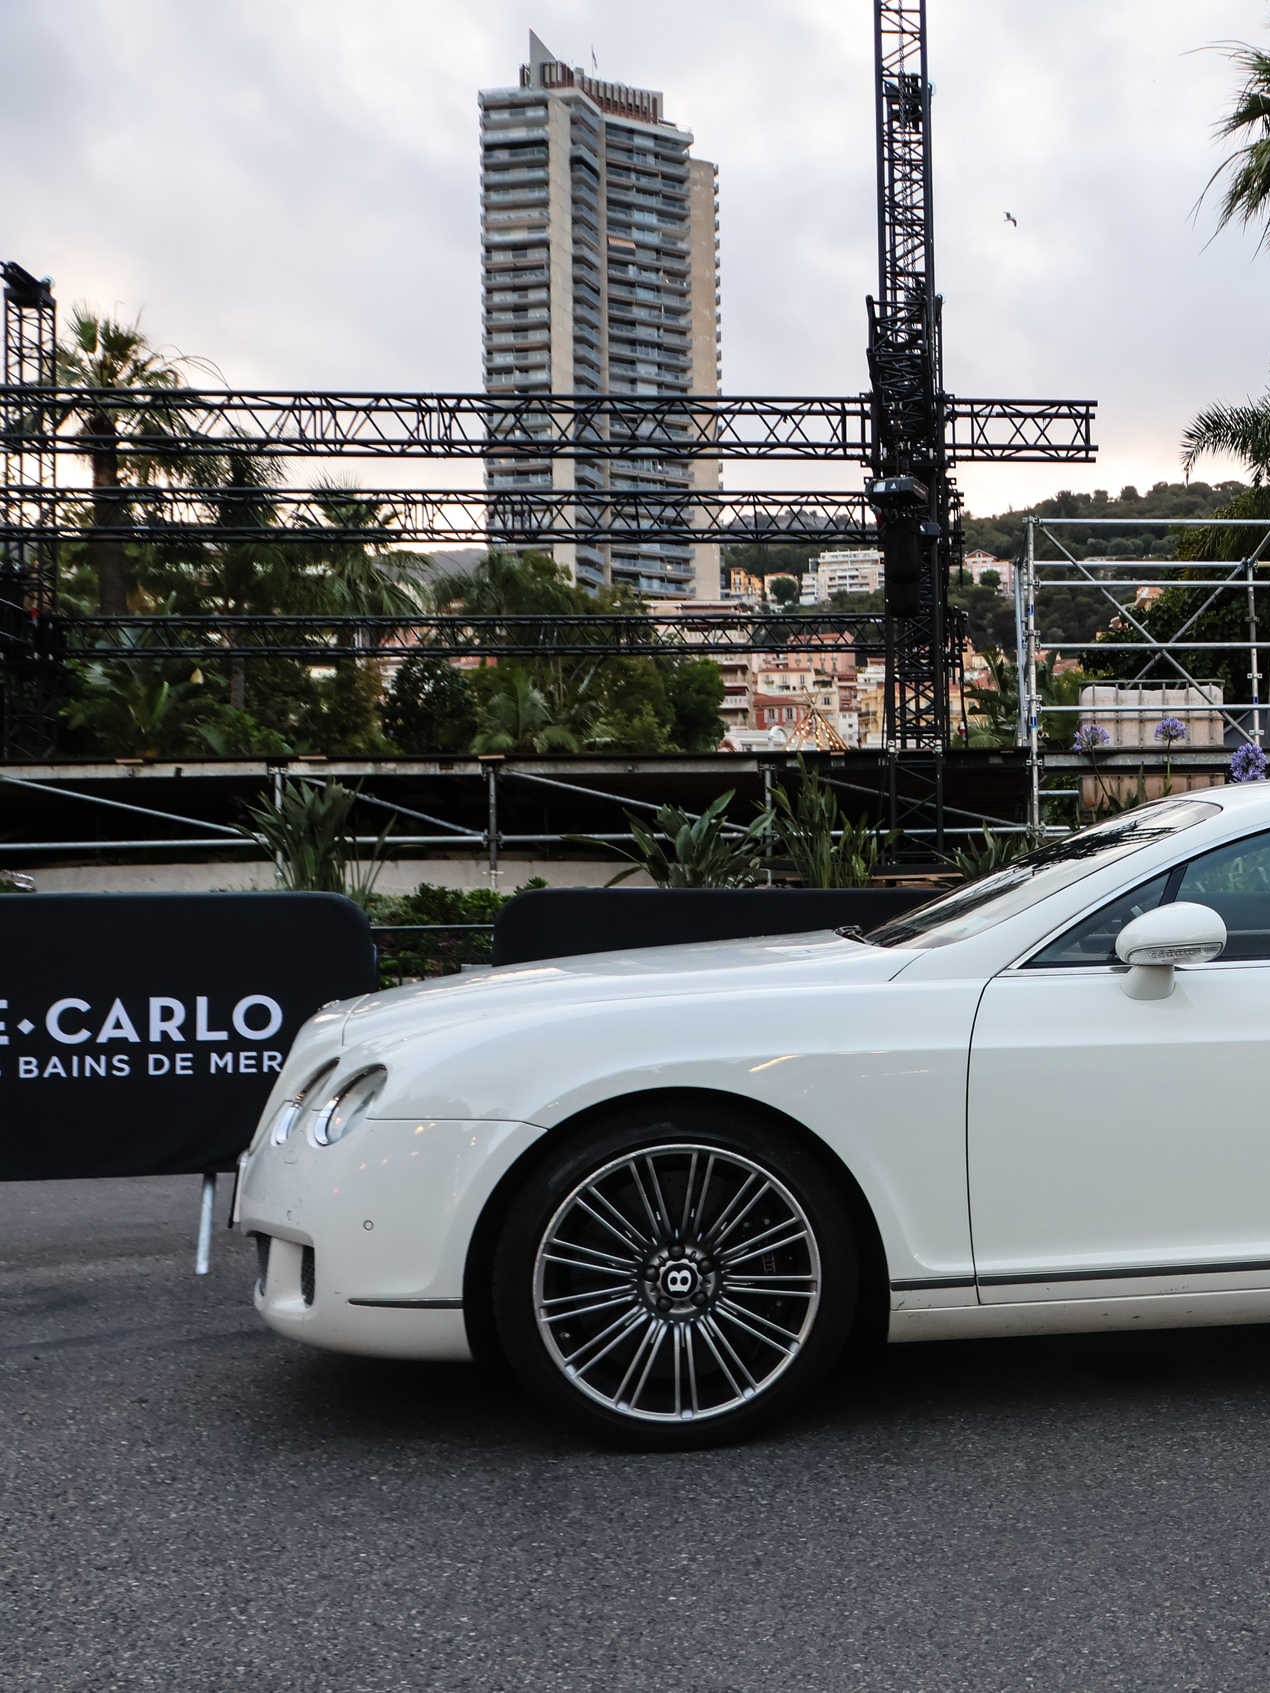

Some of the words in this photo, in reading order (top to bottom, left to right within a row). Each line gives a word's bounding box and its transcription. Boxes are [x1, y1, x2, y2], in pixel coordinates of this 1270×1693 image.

[18, 1054, 131, 1079] BAINS
[148, 1053, 194, 1076] DE
[209, 1051, 283, 1074] MER
[667, 1269, 692, 1292] B
